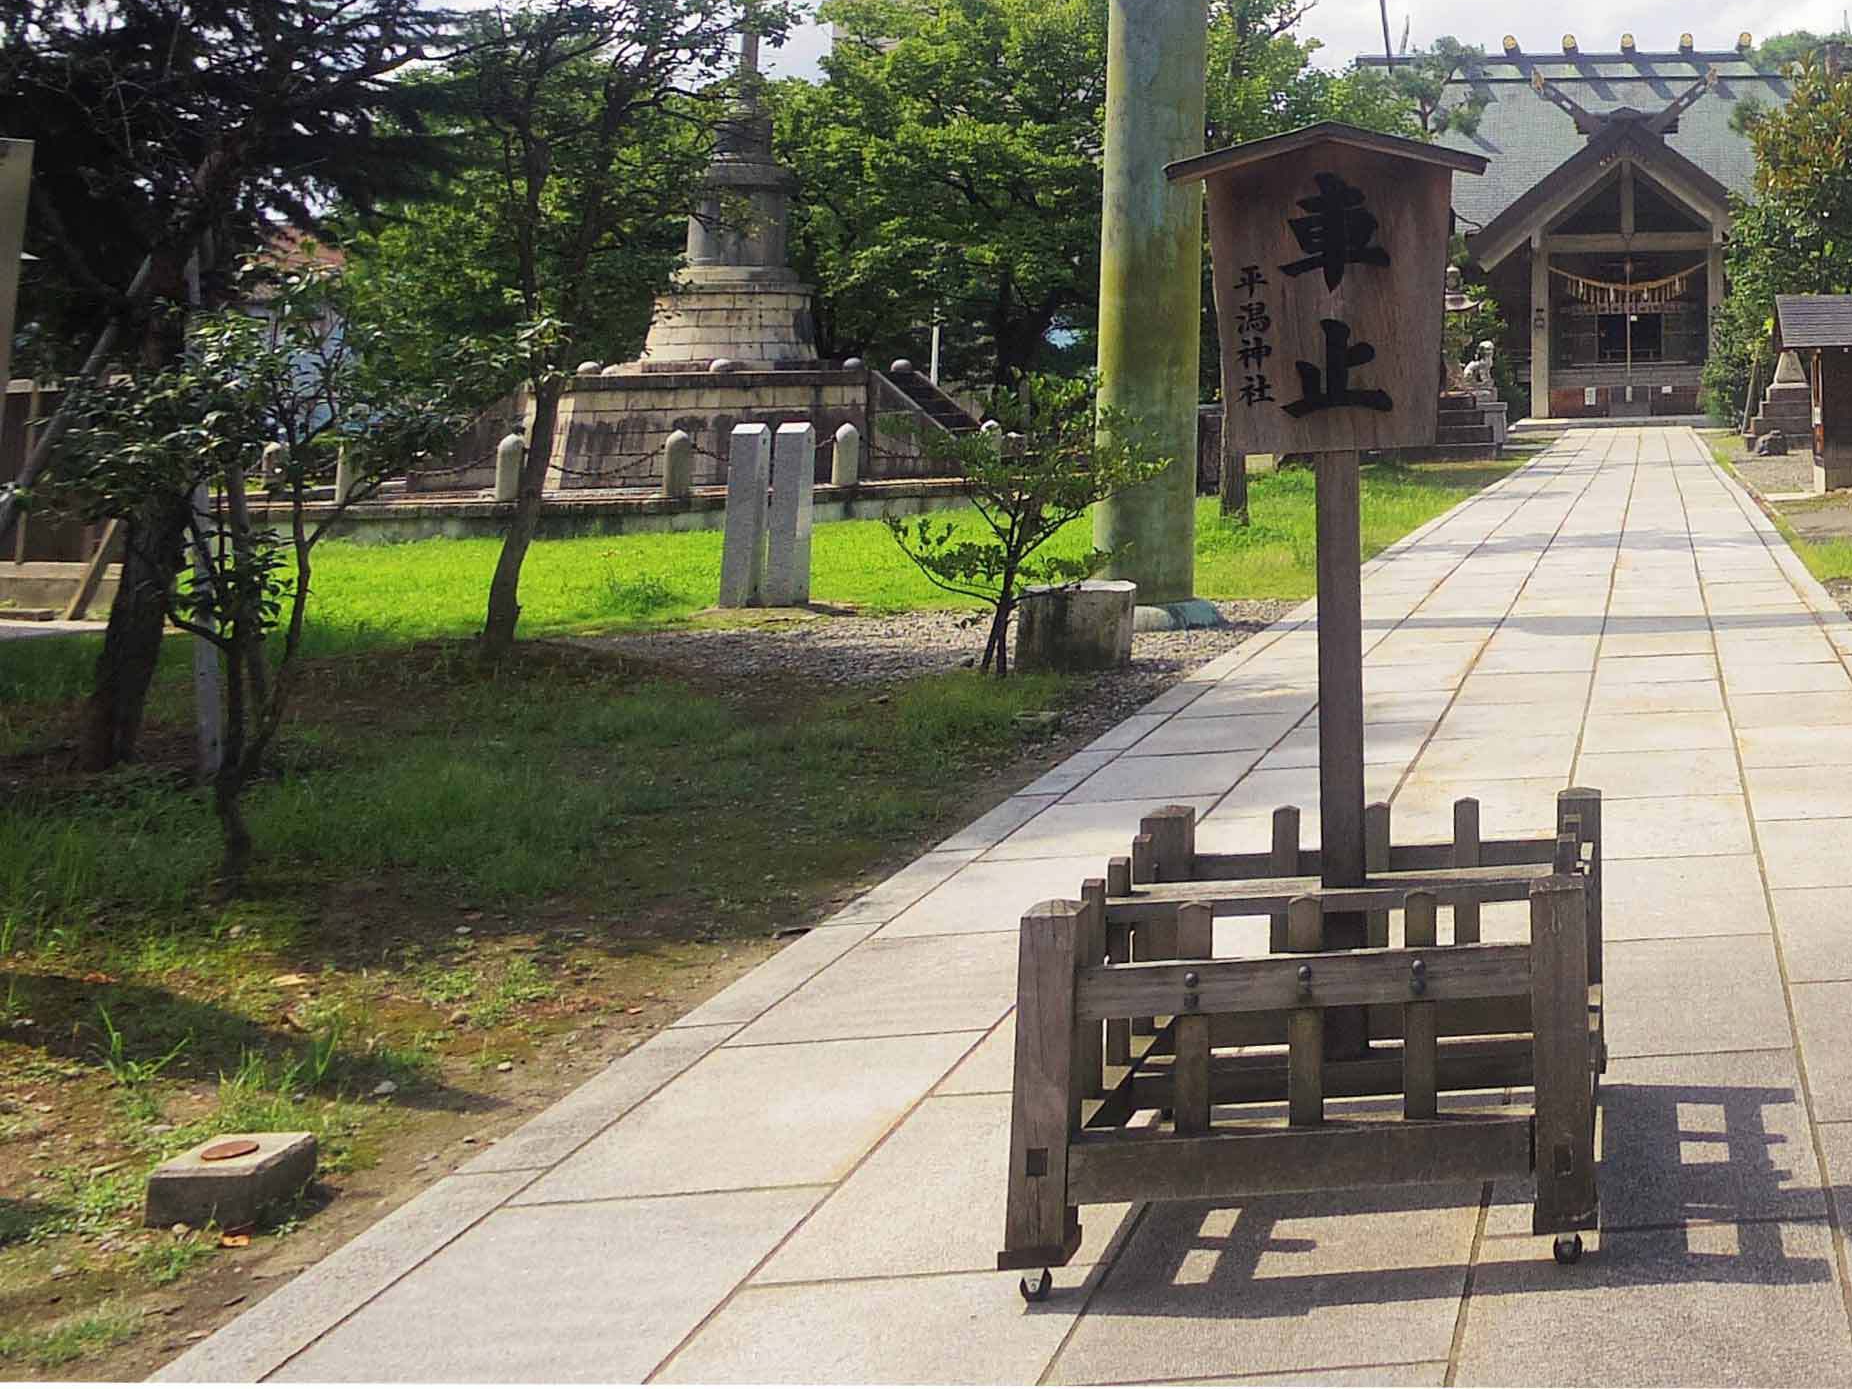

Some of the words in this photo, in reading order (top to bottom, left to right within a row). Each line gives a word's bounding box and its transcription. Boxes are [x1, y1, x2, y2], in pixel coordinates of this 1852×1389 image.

[1233, 265, 1275, 406] 平潟神社
[1278, 171, 1393, 418] 車止
